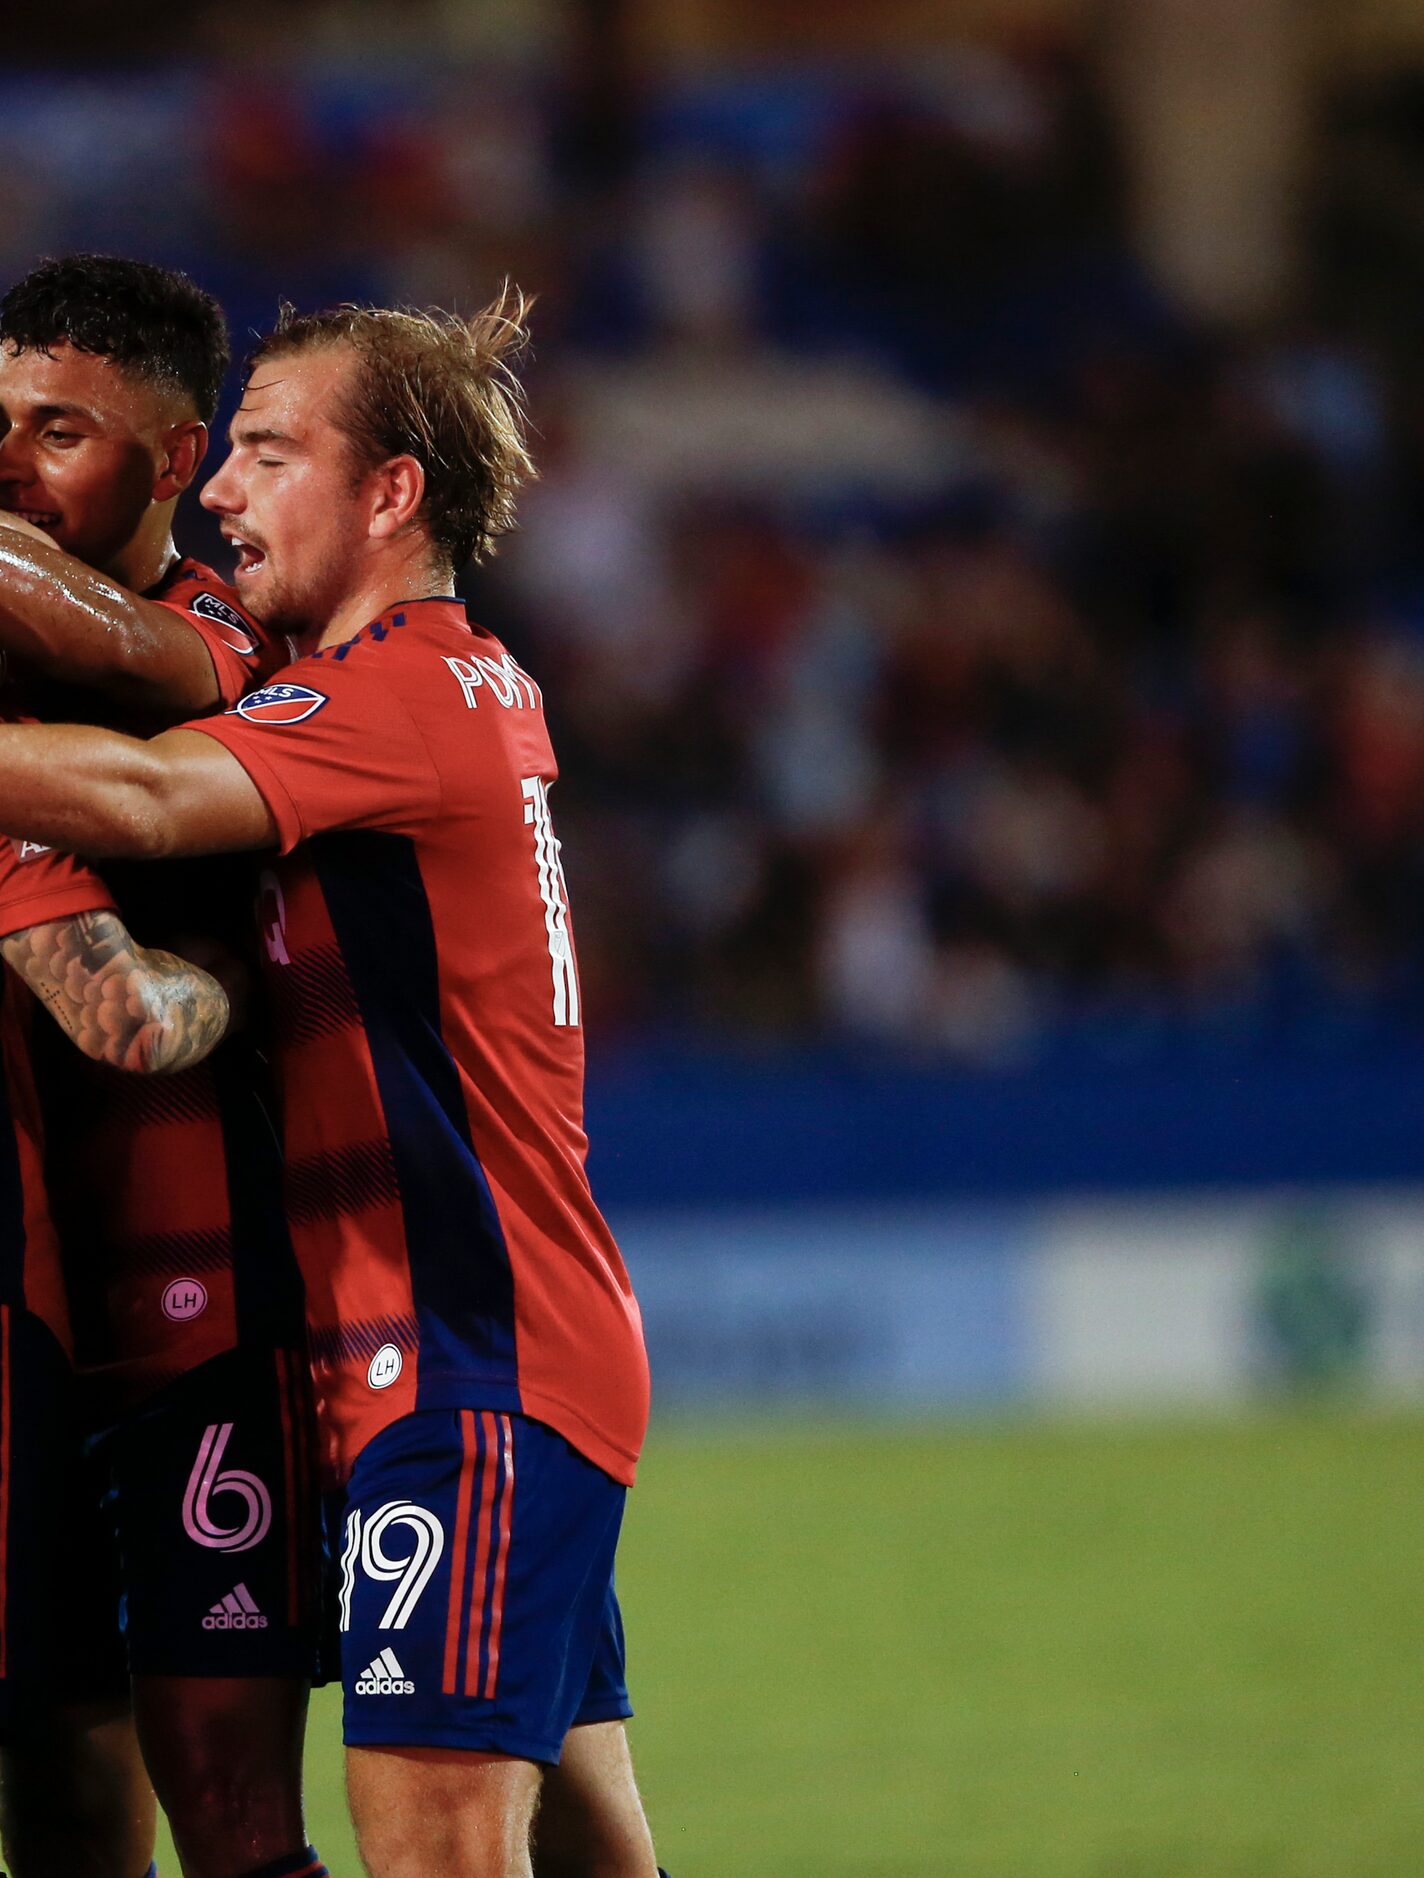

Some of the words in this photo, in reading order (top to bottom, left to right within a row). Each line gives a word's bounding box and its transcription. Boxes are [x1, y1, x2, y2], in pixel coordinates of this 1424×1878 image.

[205, 598, 239, 624] MLS
[256, 686, 294, 698] MLS
[172, 1292, 197, 1309] LH
[376, 1358, 394, 1377] LH
[182, 1422, 272, 1553] 6
[338, 1500, 444, 1632] 19
[201, 1611, 268, 1631] adidas
[355, 1675, 415, 1695] adidas
